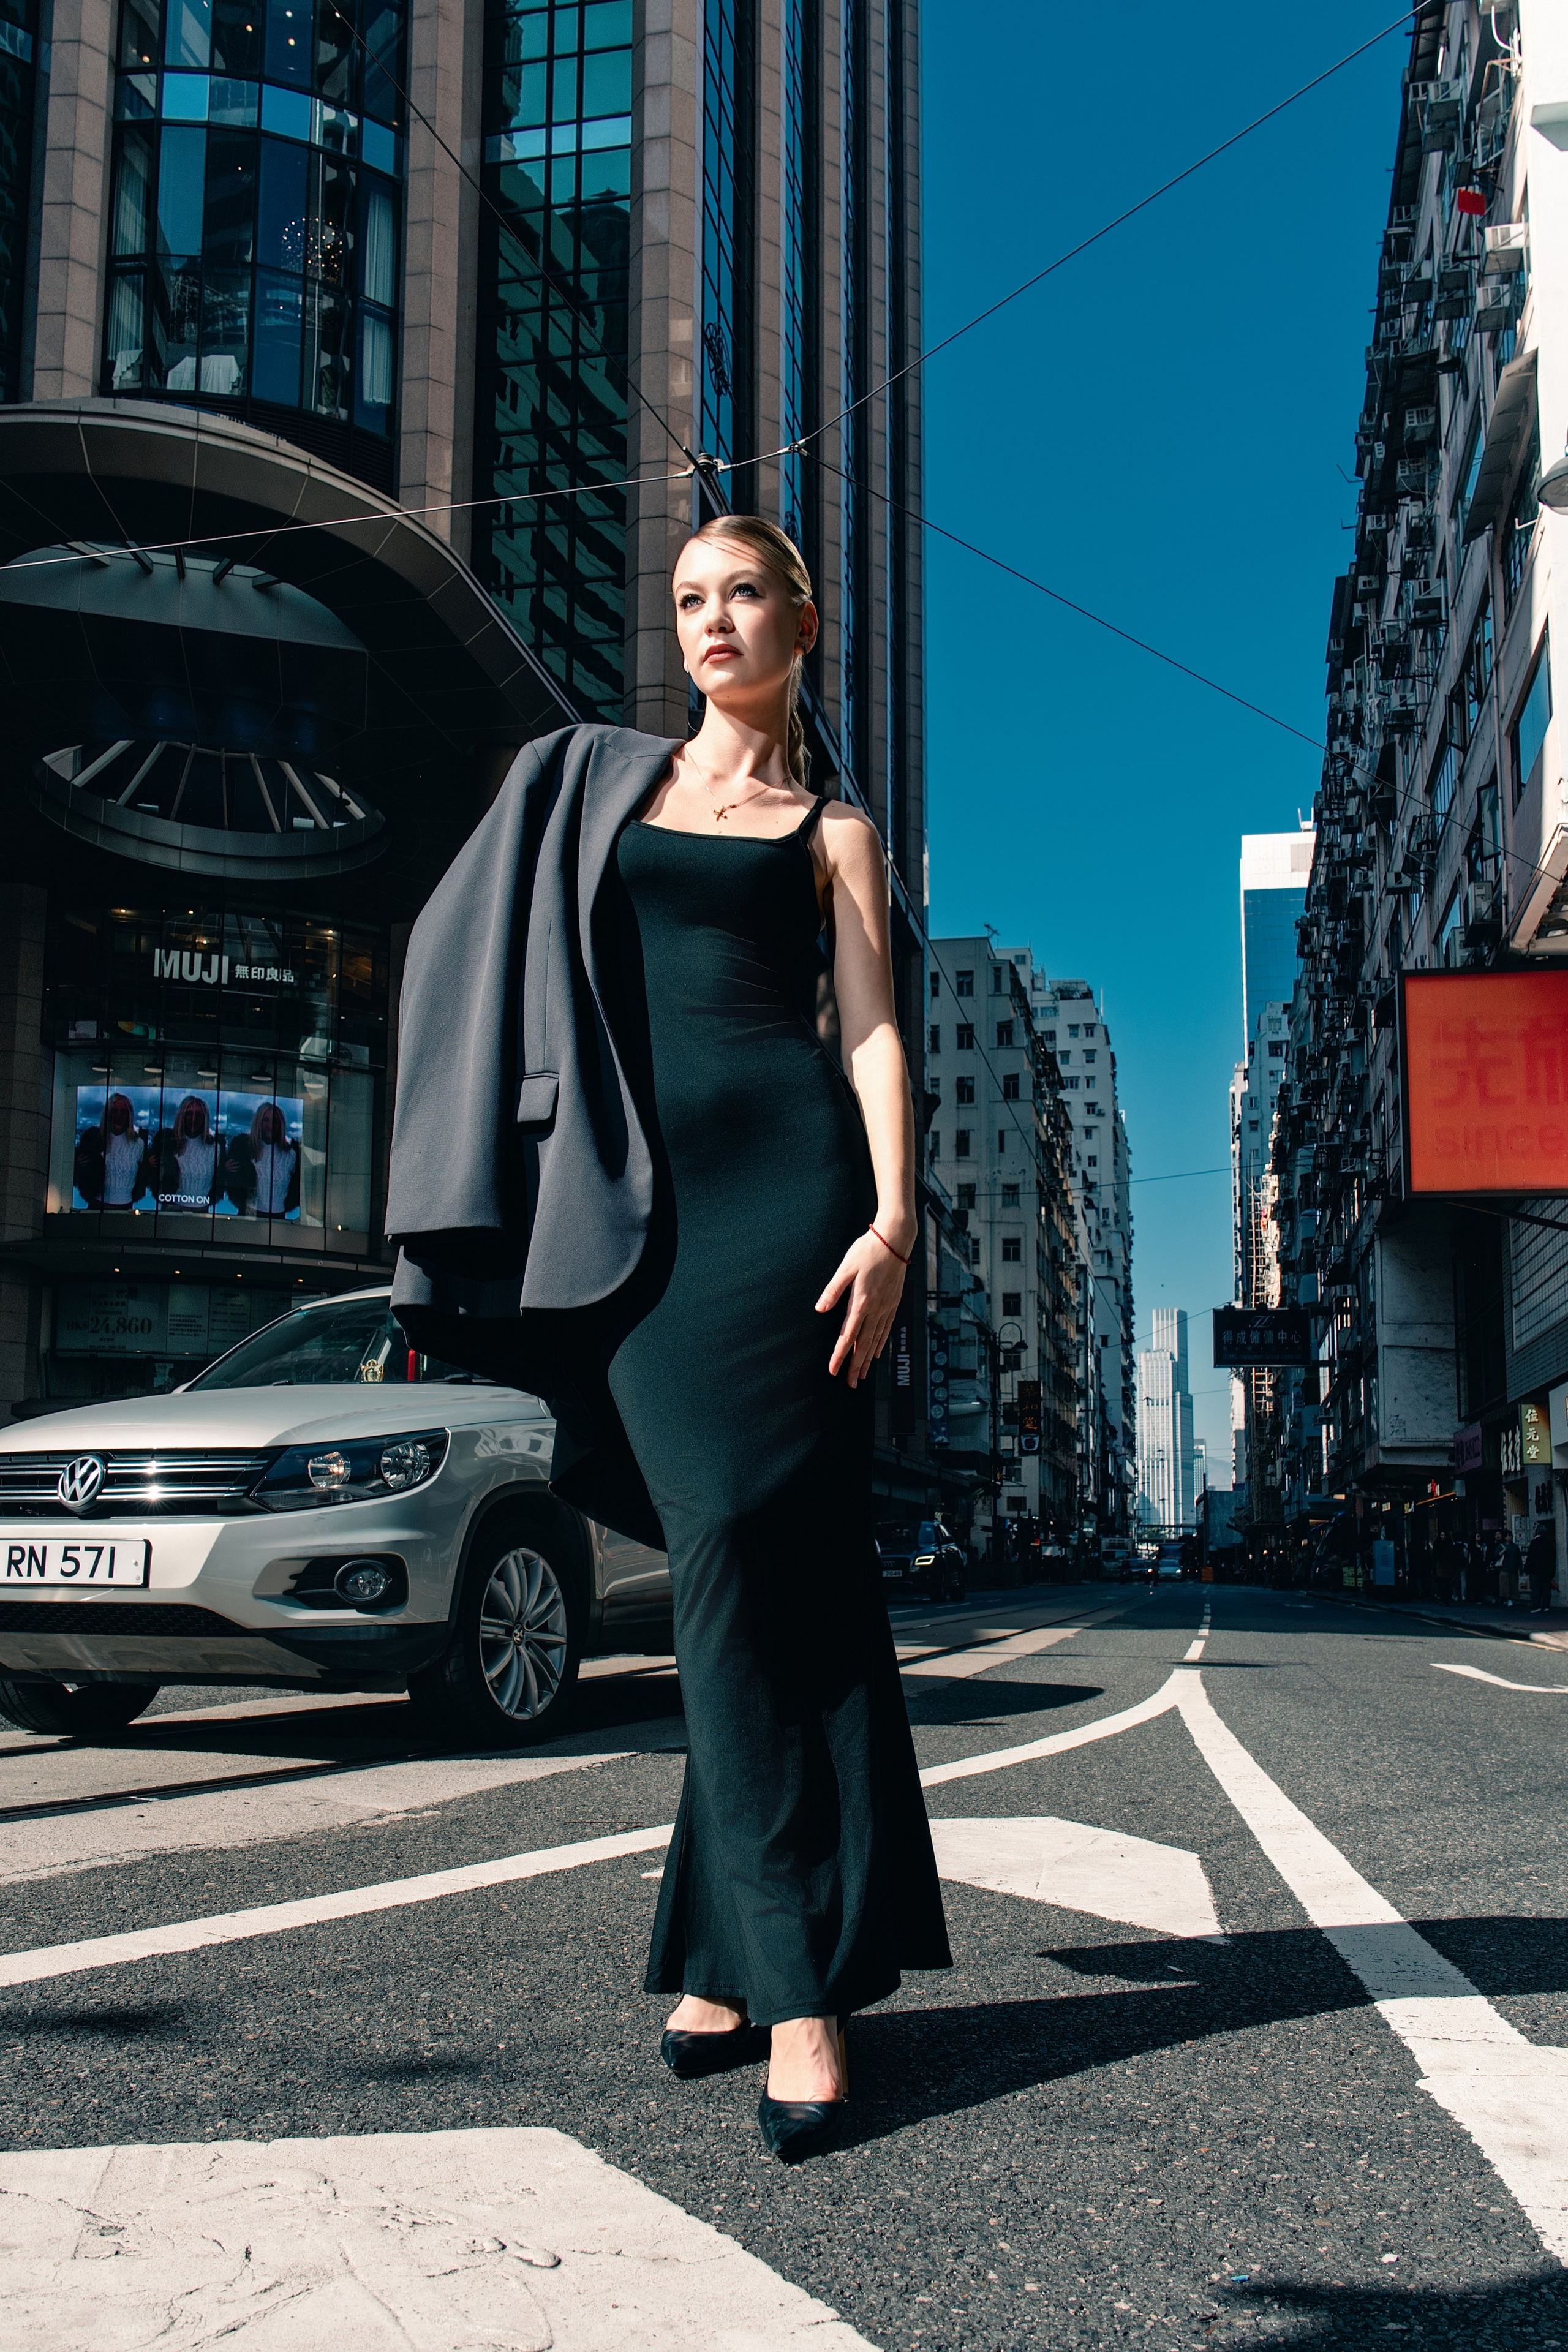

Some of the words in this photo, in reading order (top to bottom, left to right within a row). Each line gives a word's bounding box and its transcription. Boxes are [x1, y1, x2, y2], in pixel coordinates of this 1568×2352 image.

[153, 948, 230, 985] MUJI
[235, 963, 295, 983] 無印良品
[158, 1193, 195, 1204] COTTON
[196, 1196, 210, 1205] ON
[1223, 1329, 1302, 1344] 得成僱傭中心
[897, 1354, 910, 1386] MUJI
[1525, 1408, 1539, 1460] 位元堂
[6, 1545, 47, 1577] RN
[59, 1545, 116, 1578] 571
